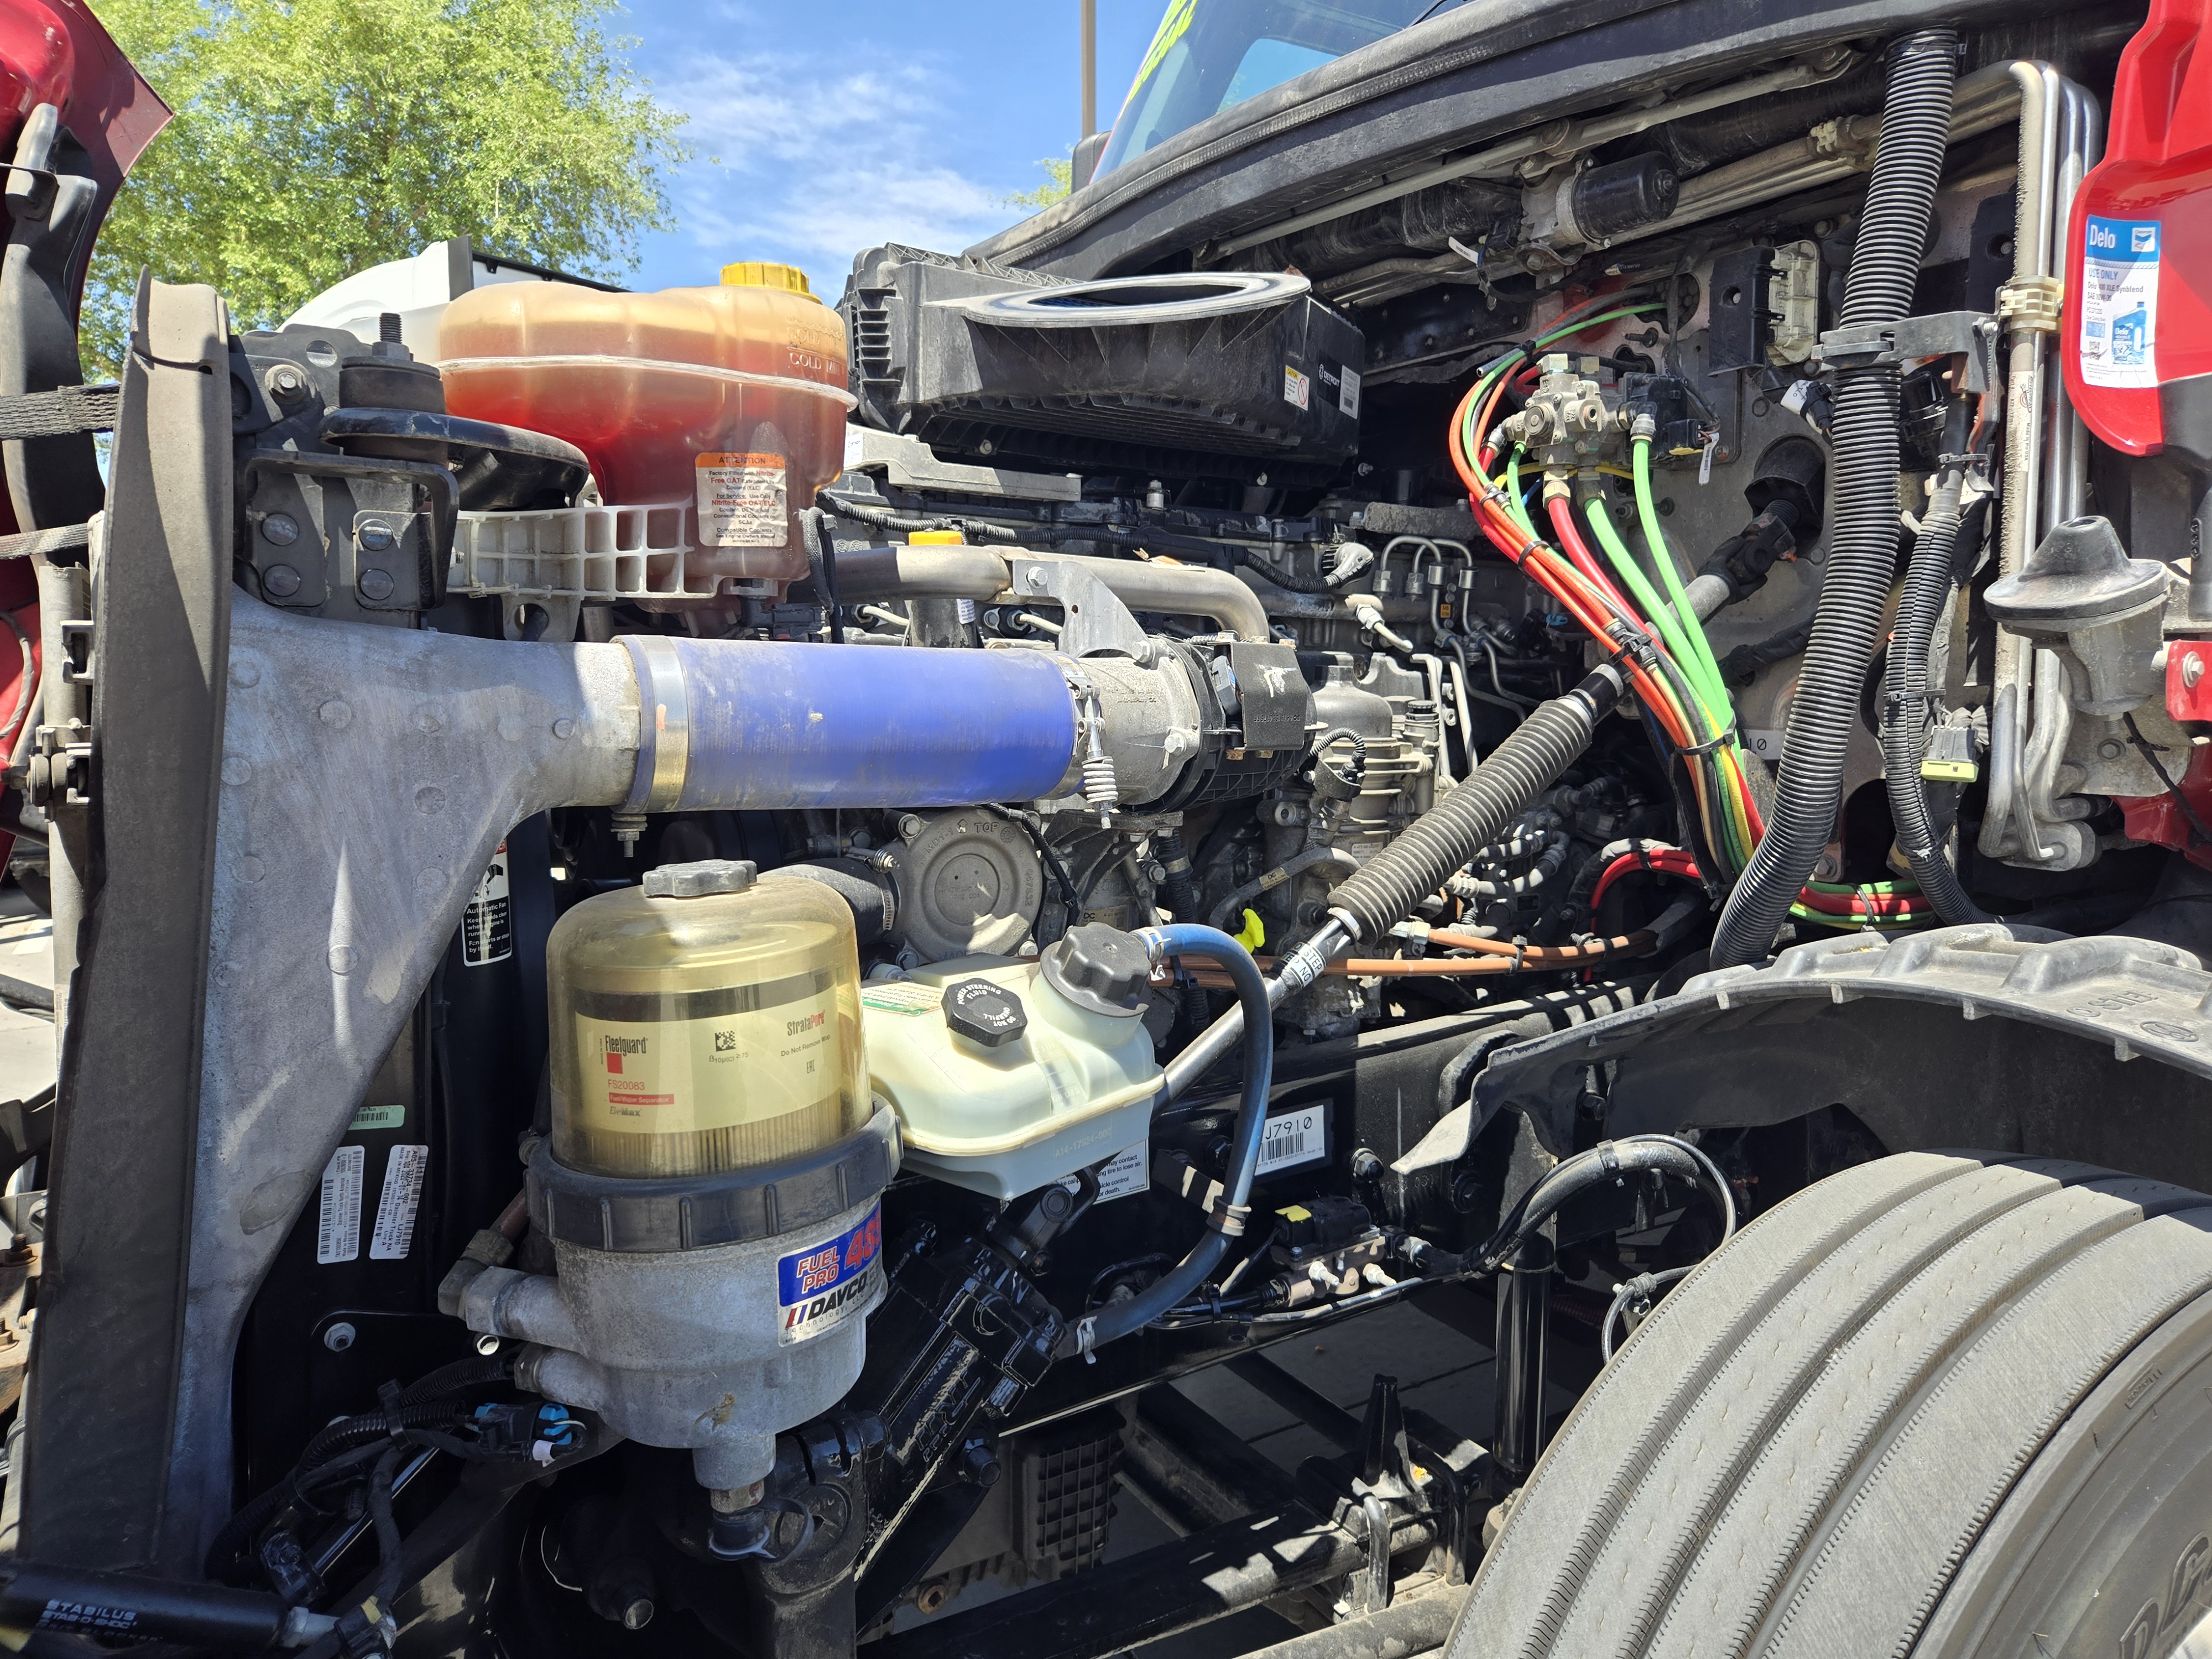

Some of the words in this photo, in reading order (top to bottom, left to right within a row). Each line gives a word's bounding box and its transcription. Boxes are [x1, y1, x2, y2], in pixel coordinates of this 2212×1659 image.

[2089, 225, 2116, 248] Delo
[2089, 268, 2099, 278] USE
[2101, 270, 2119, 280] ONLY
[789, 352, 822, 369] COLD
[1323, 371, 1340, 387] DETROIT
[1749, 738, 1767, 750] 10
[974, 822, 1000, 833] TOP
[467, 905, 498, 914] Automatic
[1303, 949, 1322, 970] STEP
[1299, 966, 1311, 982] NO
[957, 988, 968, 1005] POWER
[966, 984, 1001, 994] STEERING
[967, 990, 987, 999] FLUID
[983, 1007, 1010, 1020] OVERFILL
[787, 1012, 825, 1036] StrataPore
[605, 1035, 646, 1057] Fleetguard
[791, 1046, 801, 1055] Not
[802, 1039, 821, 1051] Remove
[608, 1079, 645, 1091] FS20083
[1265, 1117, 1312, 1139] J7910
[1055, 1127, 1112, 1158] A14-17924-000
[1119, 1154, 1137, 1164] contact
[1112, 1176, 1129, 1185] control
[1105, 1187, 1120, 1195] death.
[391, 1203, 400, 1224] Daimler
[388, 1226, 396, 1241] Truck
[394, 1224, 404, 1245] LJ7910
[385, 1243, 392, 1251] NA
[796, 1246, 841, 1278] FUEL
[801, 1263, 839, 1295] PRO
[807, 1270, 868, 1321] DAVCO
[852, 1290, 864, 1305] LLC
[46, 1599, 136, 1620] STABILUS
